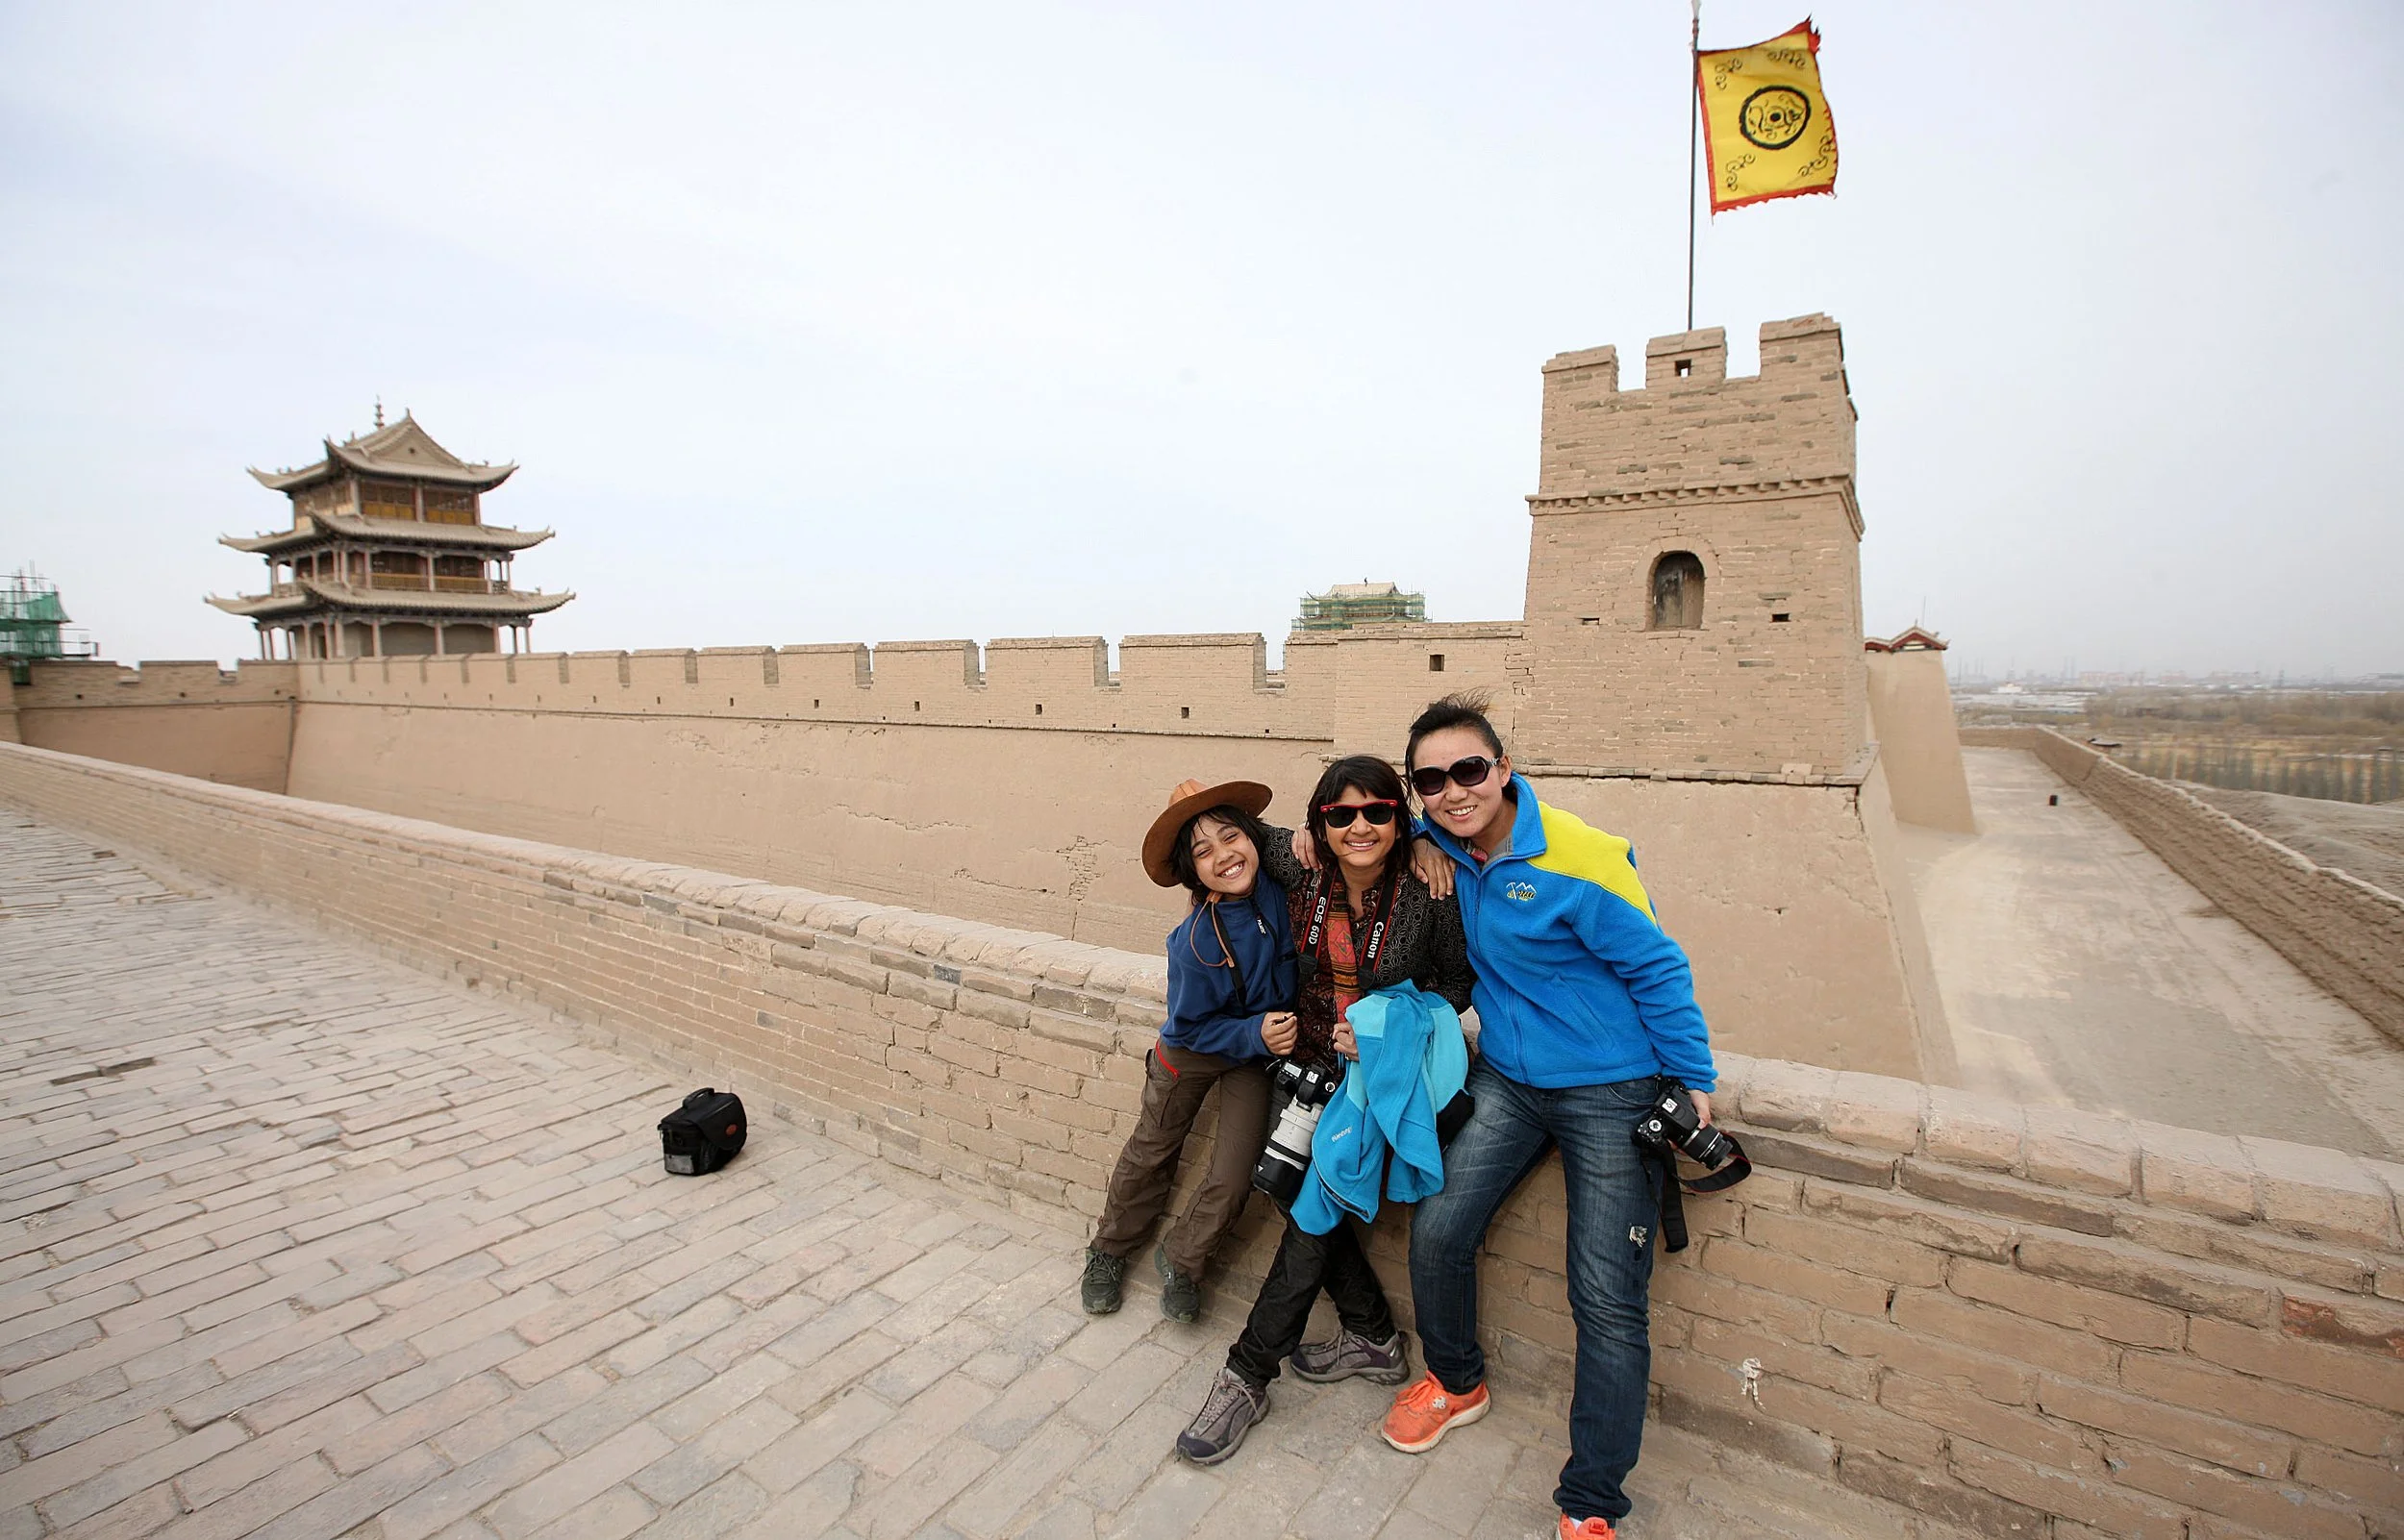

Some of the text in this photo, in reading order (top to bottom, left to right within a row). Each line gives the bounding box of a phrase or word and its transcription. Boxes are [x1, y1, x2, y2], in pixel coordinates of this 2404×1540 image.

[1308, 896, 1327, 945] EOS 60D
[1366, 921, 1385, 959] Canon
